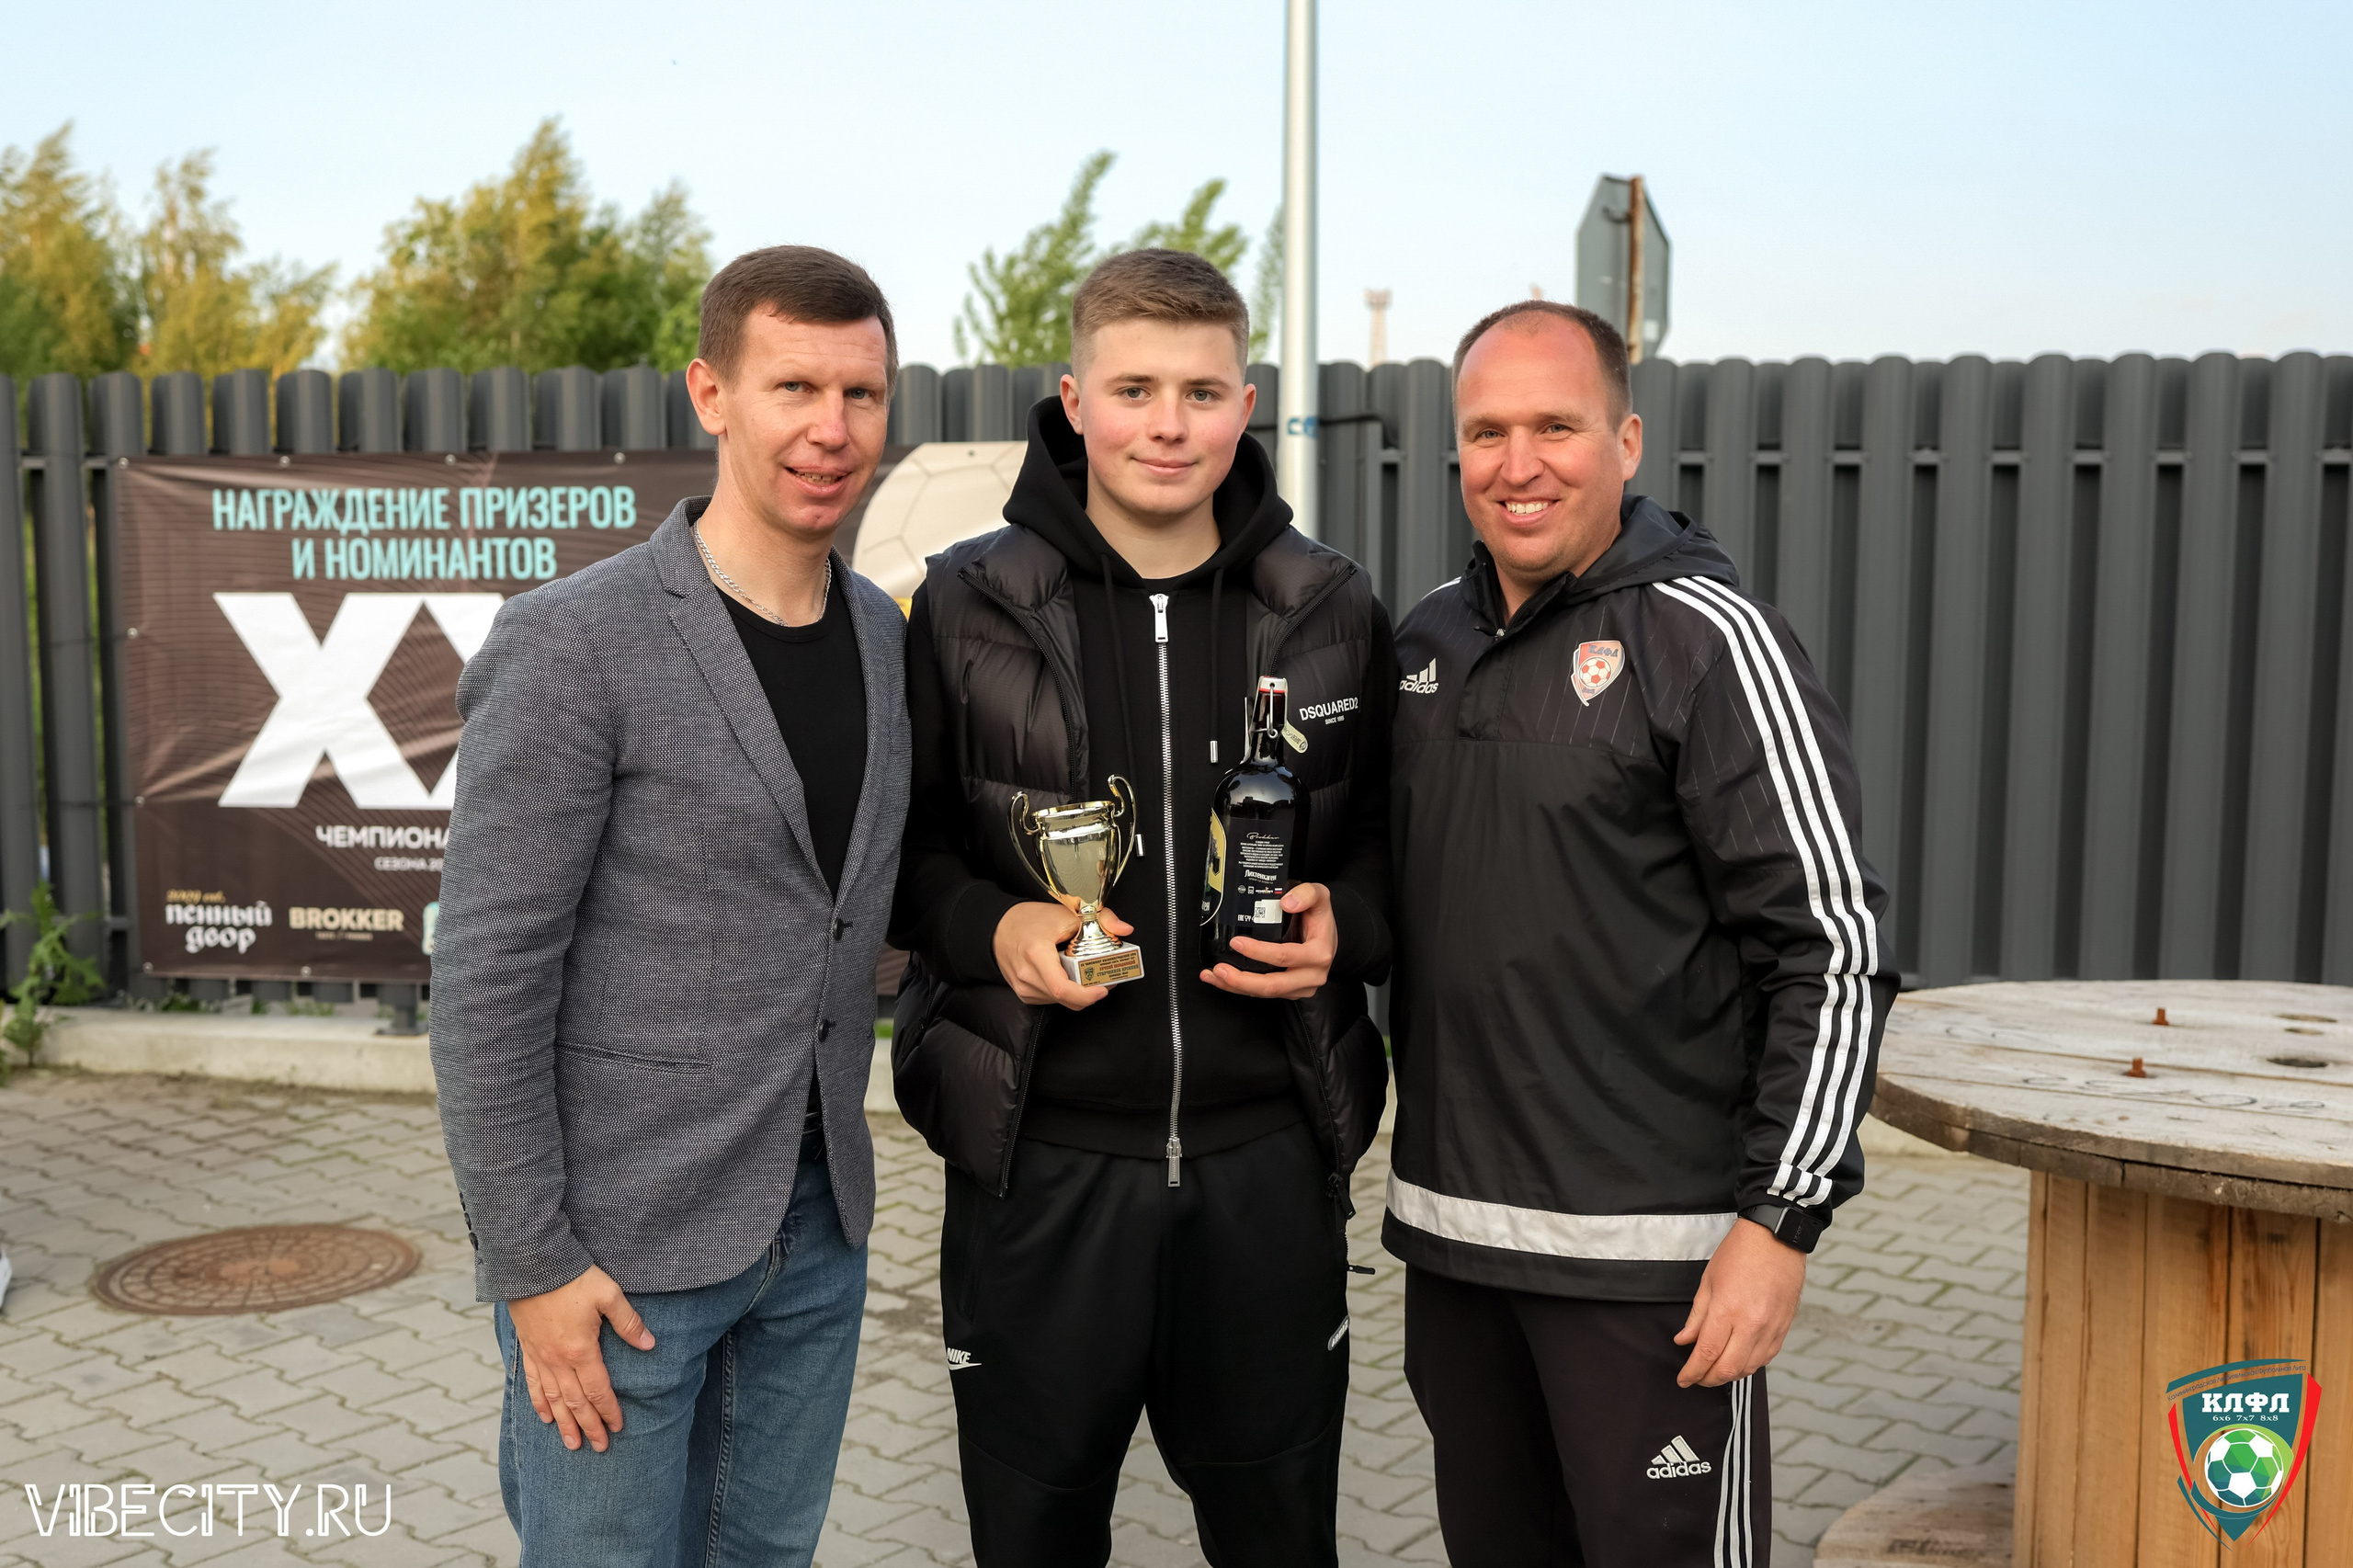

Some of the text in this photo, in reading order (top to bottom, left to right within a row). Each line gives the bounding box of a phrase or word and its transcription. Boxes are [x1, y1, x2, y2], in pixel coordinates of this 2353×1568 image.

[211, 485, 637, 537] НАГРАЖДЕНИЕ ПРИЗЕРОВ
[291, 537, 558, 580] И НОМИНАНТОВ
[1399, 680, 1439, 694] adidas
[1299, 697, 1358, 721] DSQUARED2
[315, 825, 449, 849] ЧЕМПИОН
[289, 906, 404, 931] BROKKER
[947, 1347, 972, 1364] NIKE
[1646, 1460, 1712, 1479] adidas
